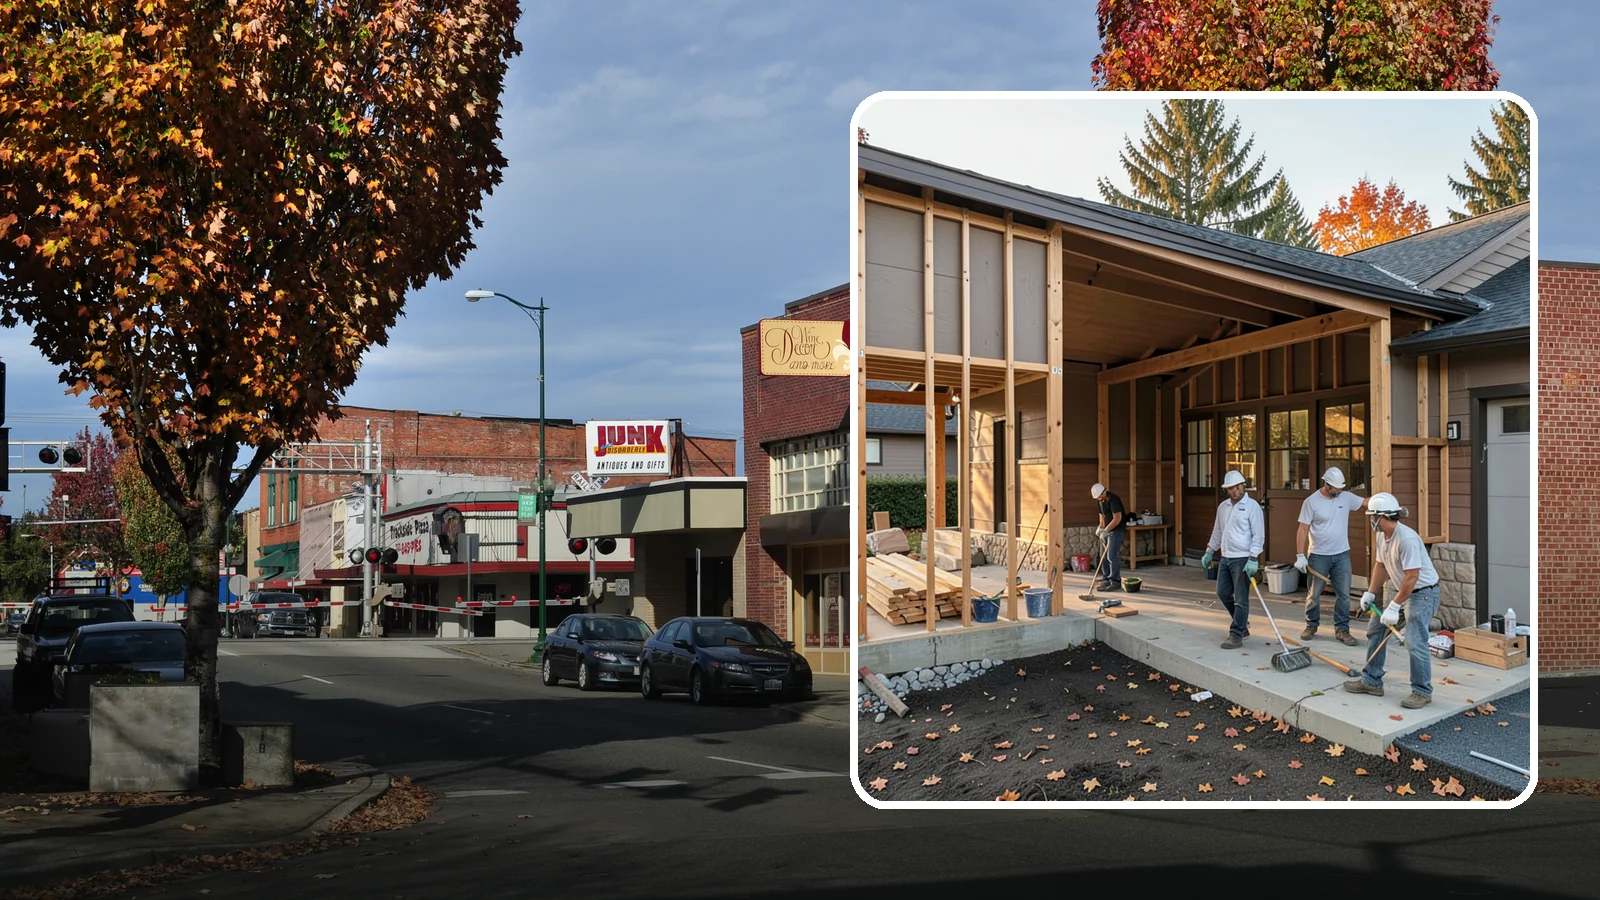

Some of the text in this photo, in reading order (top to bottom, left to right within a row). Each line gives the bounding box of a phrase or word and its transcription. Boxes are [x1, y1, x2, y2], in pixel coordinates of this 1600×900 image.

[765, 328, 831, 365] Decor
[596, 425, 665, 457] JUNK
[607, 446, 646, 454] DISORDERLY
[597, 460, 665, 470] ANTIQUES AND GIFTS
[414, 519, 429, 535] Pizza
